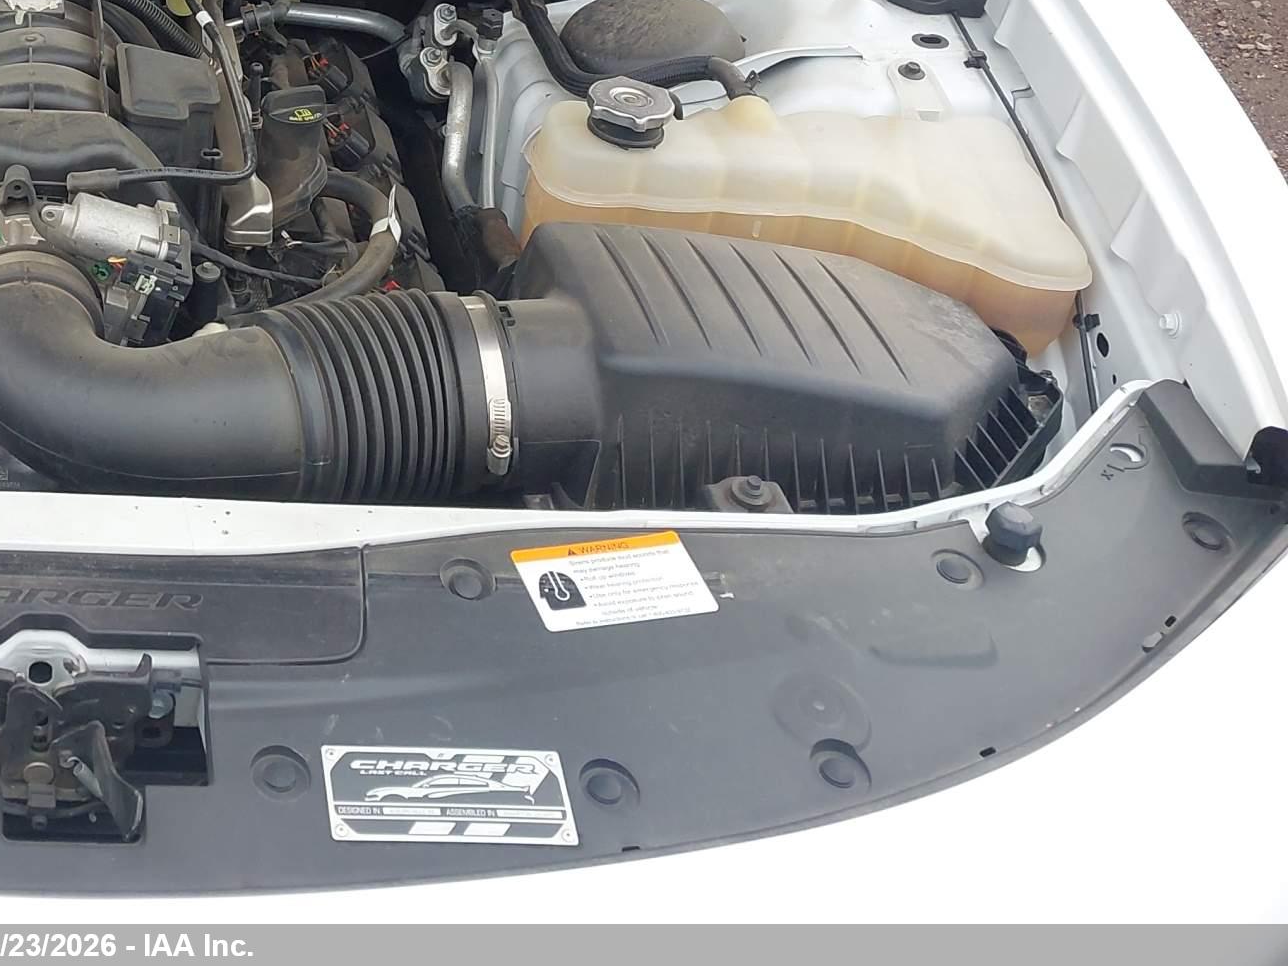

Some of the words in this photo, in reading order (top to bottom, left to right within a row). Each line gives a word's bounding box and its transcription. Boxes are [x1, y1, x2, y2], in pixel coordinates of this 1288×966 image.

[579, 542, 630, 555] WARNING
[349, 759, 541, 775] CHARGER
[338, 806, 372, 815] DESIGNED
[373, 807, 381, 816] IN
[446, 807, 487, 817] ASSEMBLED
[488, 809, 496, 817] IN
